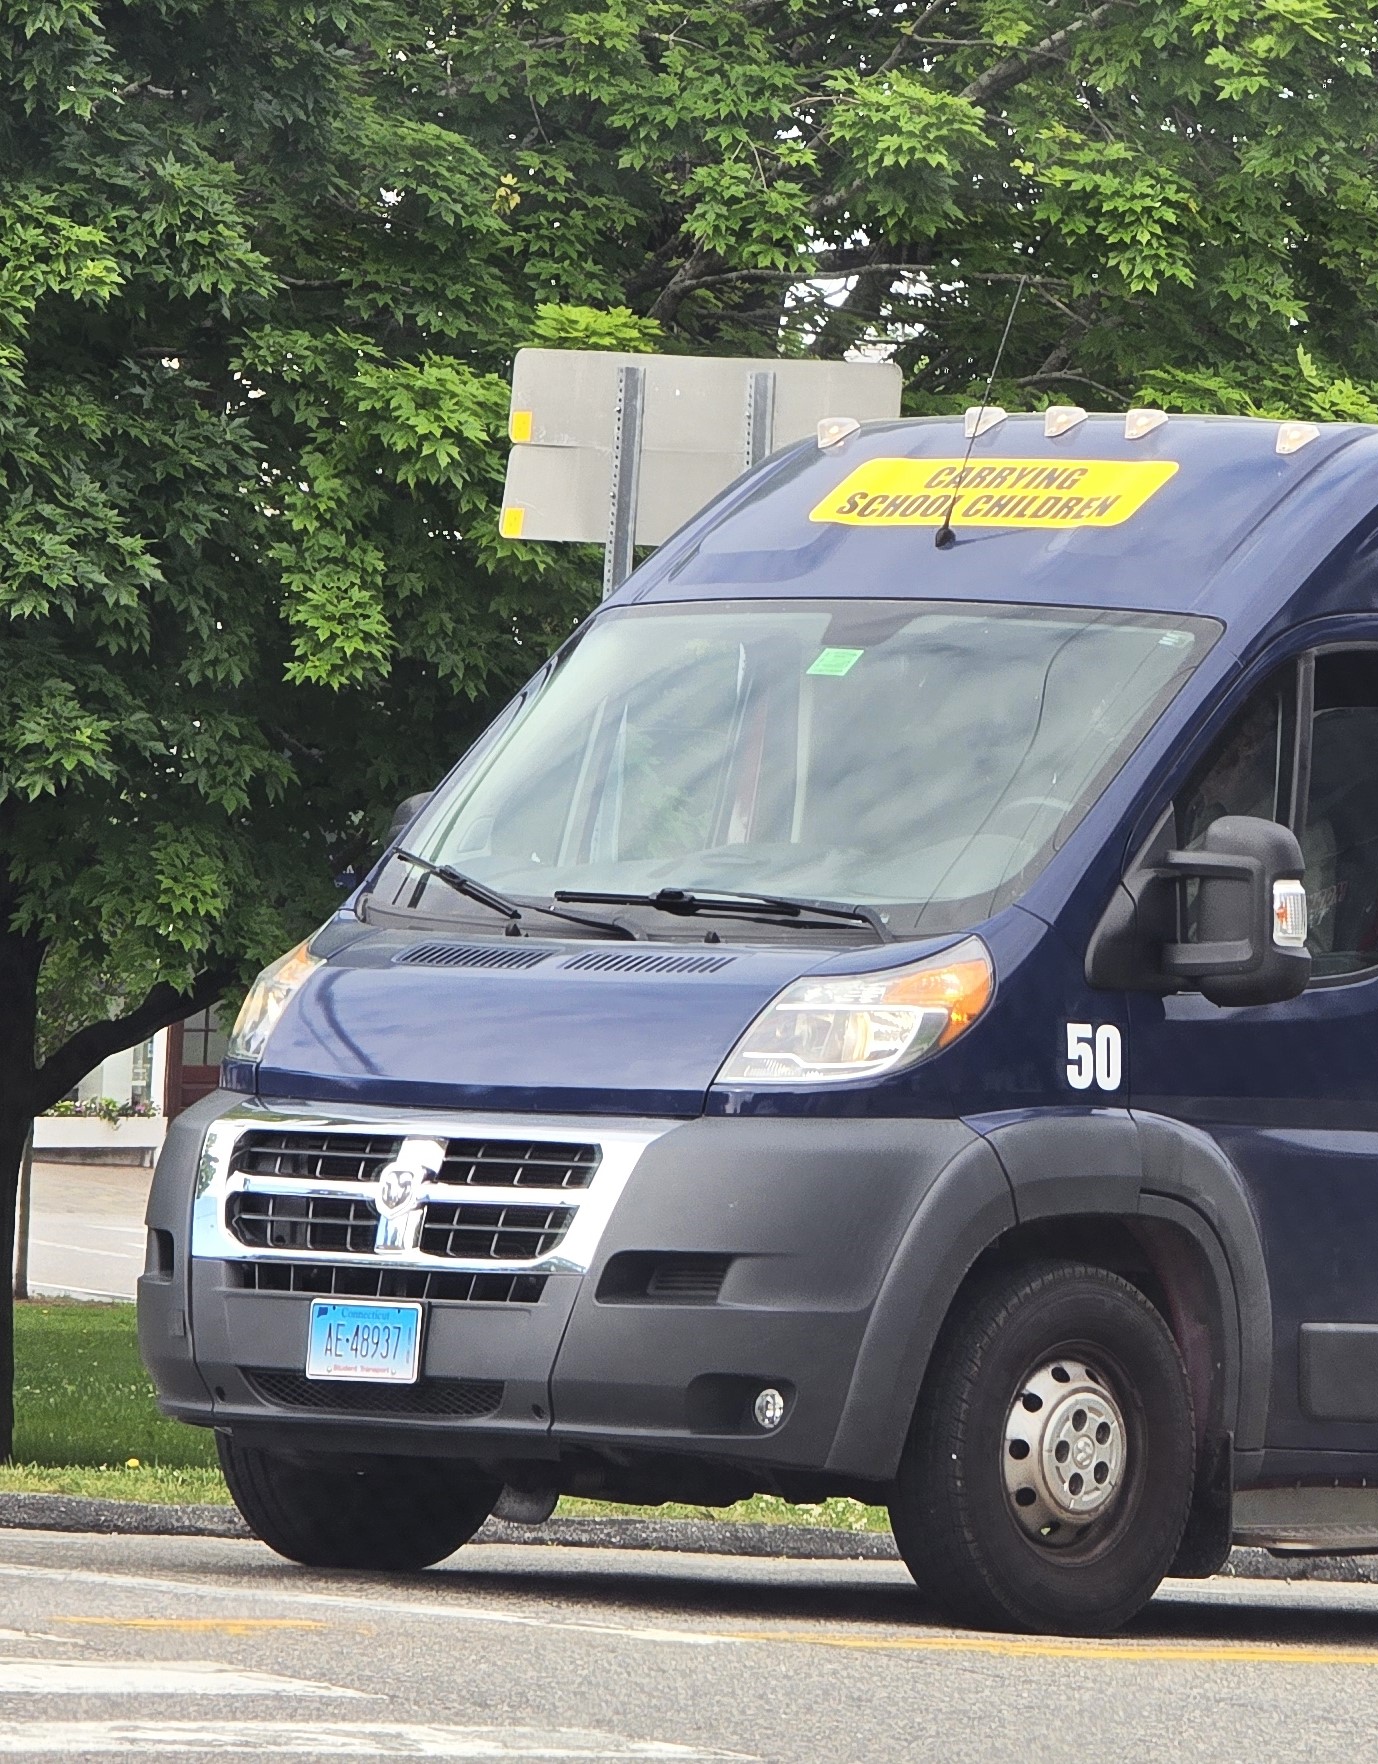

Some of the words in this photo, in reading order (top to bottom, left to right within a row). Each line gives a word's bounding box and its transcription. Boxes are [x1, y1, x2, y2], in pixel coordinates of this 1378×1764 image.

[923, 466, 1089, 489] CARRYING
[961, 494, 1122, 519] CHILDREN
[1066, 1022, 1122, 1091] 50
[341, 1307, 391, 1320] Connecticut
